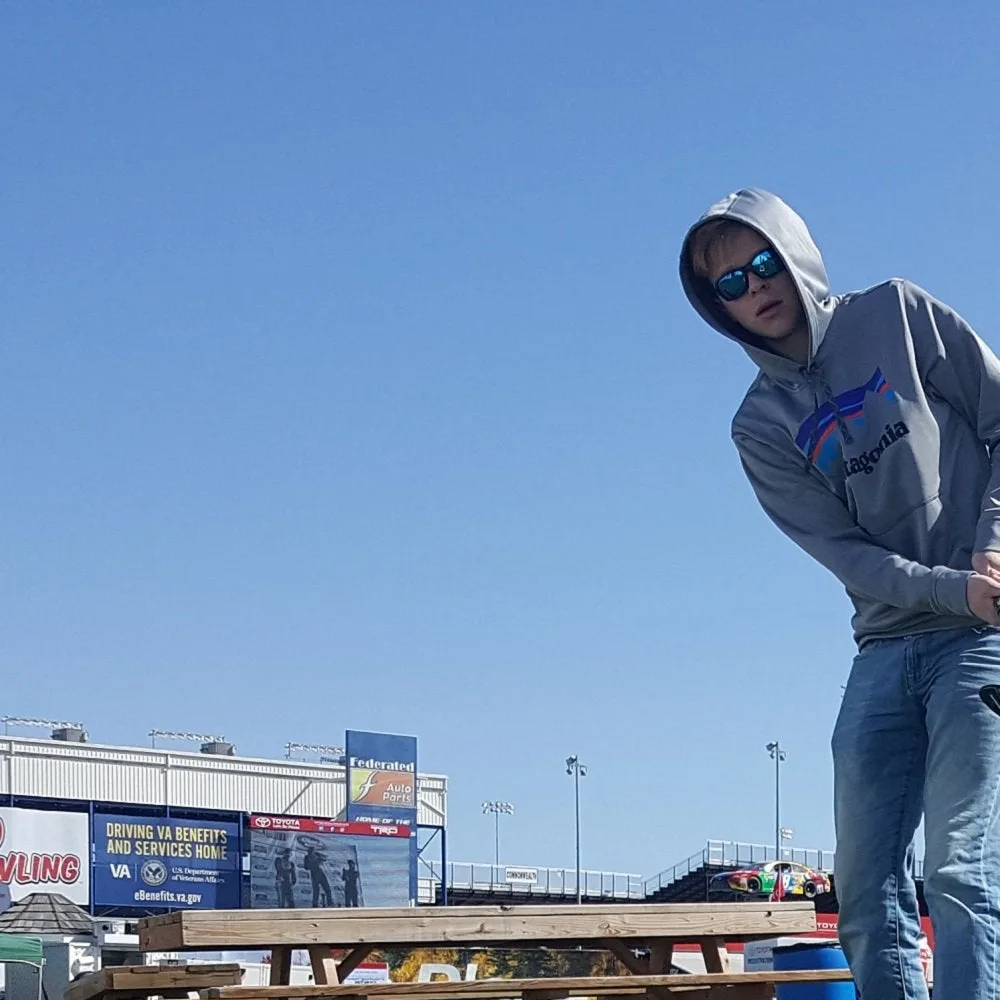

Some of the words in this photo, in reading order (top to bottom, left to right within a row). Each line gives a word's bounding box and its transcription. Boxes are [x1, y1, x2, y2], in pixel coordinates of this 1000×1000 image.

[349, 757, 415, 772] Federated
[386, 783, 411, 793] Auto
[382, 792, 411, 803] Parts
[272, 818, 300, 826] TOYOTA
[106, 822, 153, 839] DRIVING
[157, 826, 172, 841] VA
[176, 827, 227, 844] BENEFITS
[107, 840, 131, 855] AND
[135, 841, 192, 858] SERVICES
[195, 844, 227, 860] HOME
[110, 864, 131, 879] VA
[134, 889, 202, 904] eBenefits.va.gov
